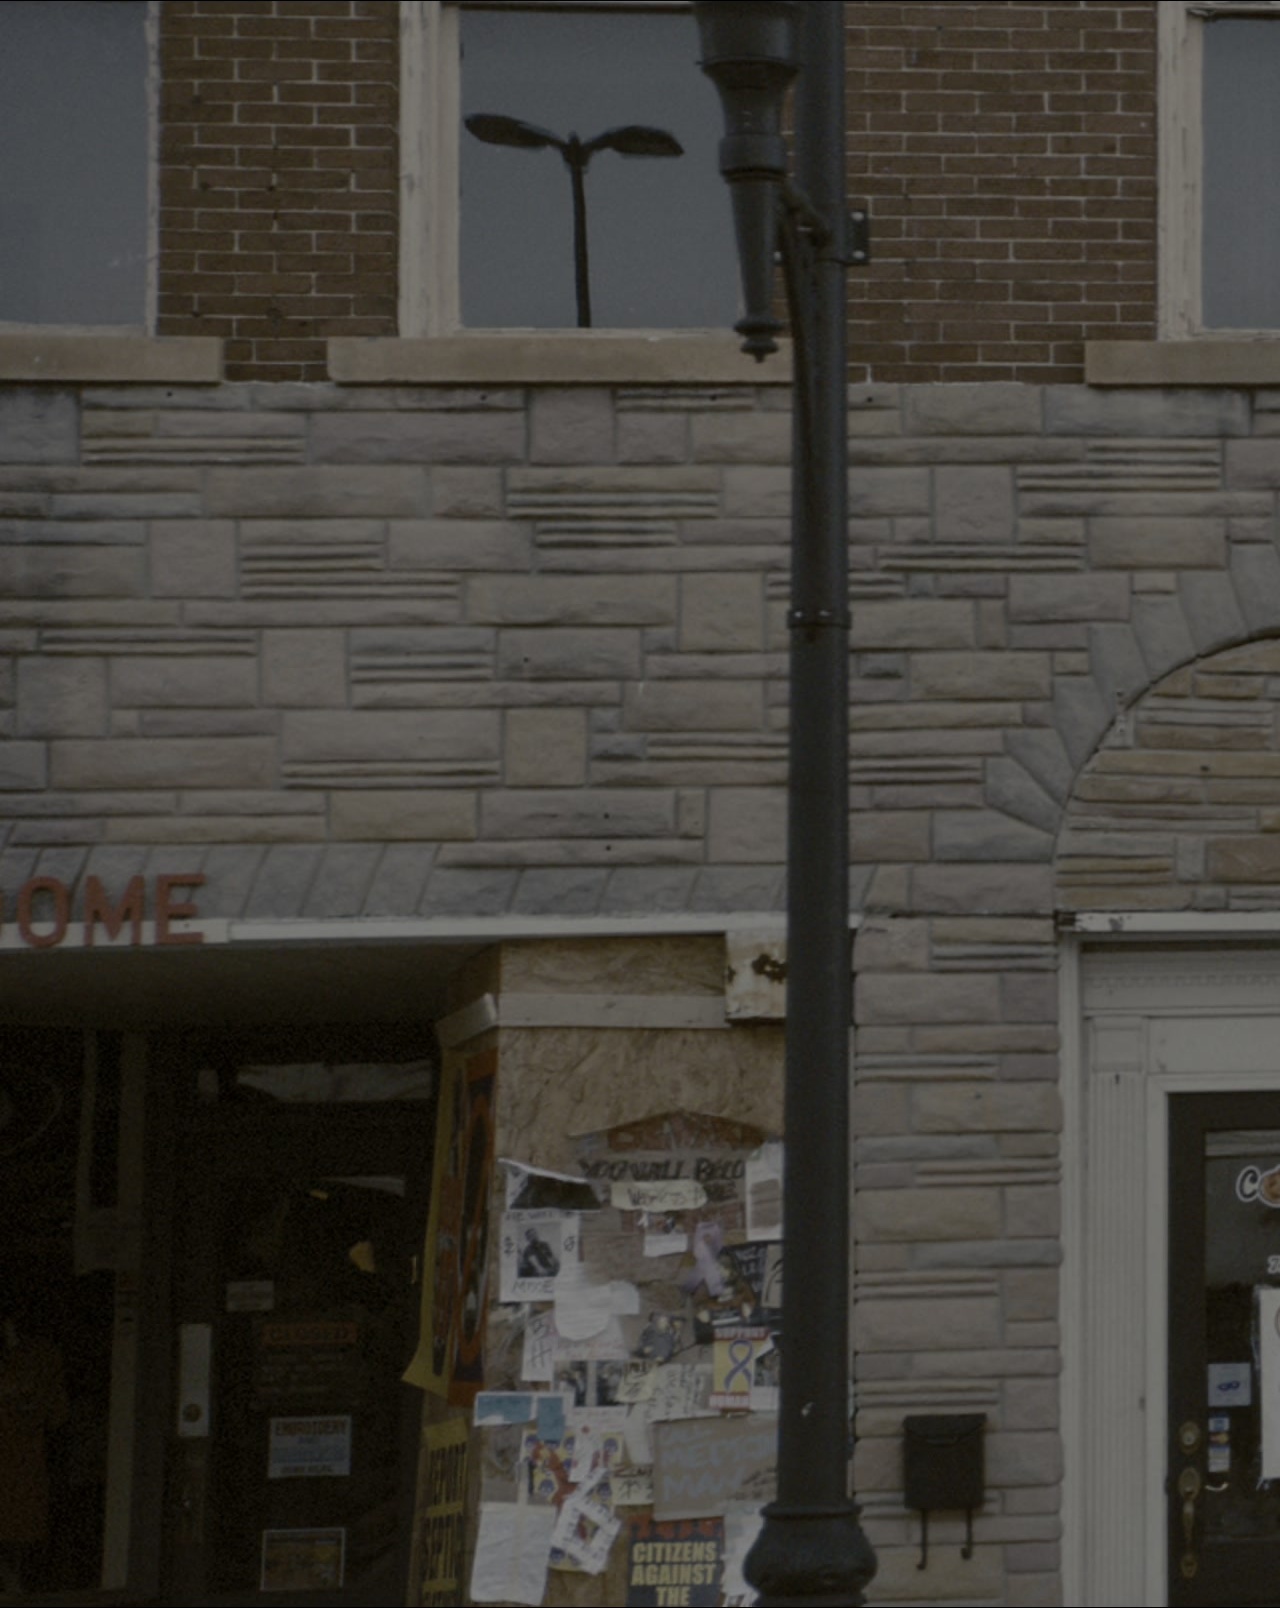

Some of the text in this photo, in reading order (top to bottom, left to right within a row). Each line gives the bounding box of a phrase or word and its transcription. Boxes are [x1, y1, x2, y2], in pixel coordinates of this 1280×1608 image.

[0, 874, 207, 948] OME
[632, 1541, 718, 1564] CITIZENS
[631, 1564, 717, 1586] AGAINST
[656, 1585, 691, 1606] THE
